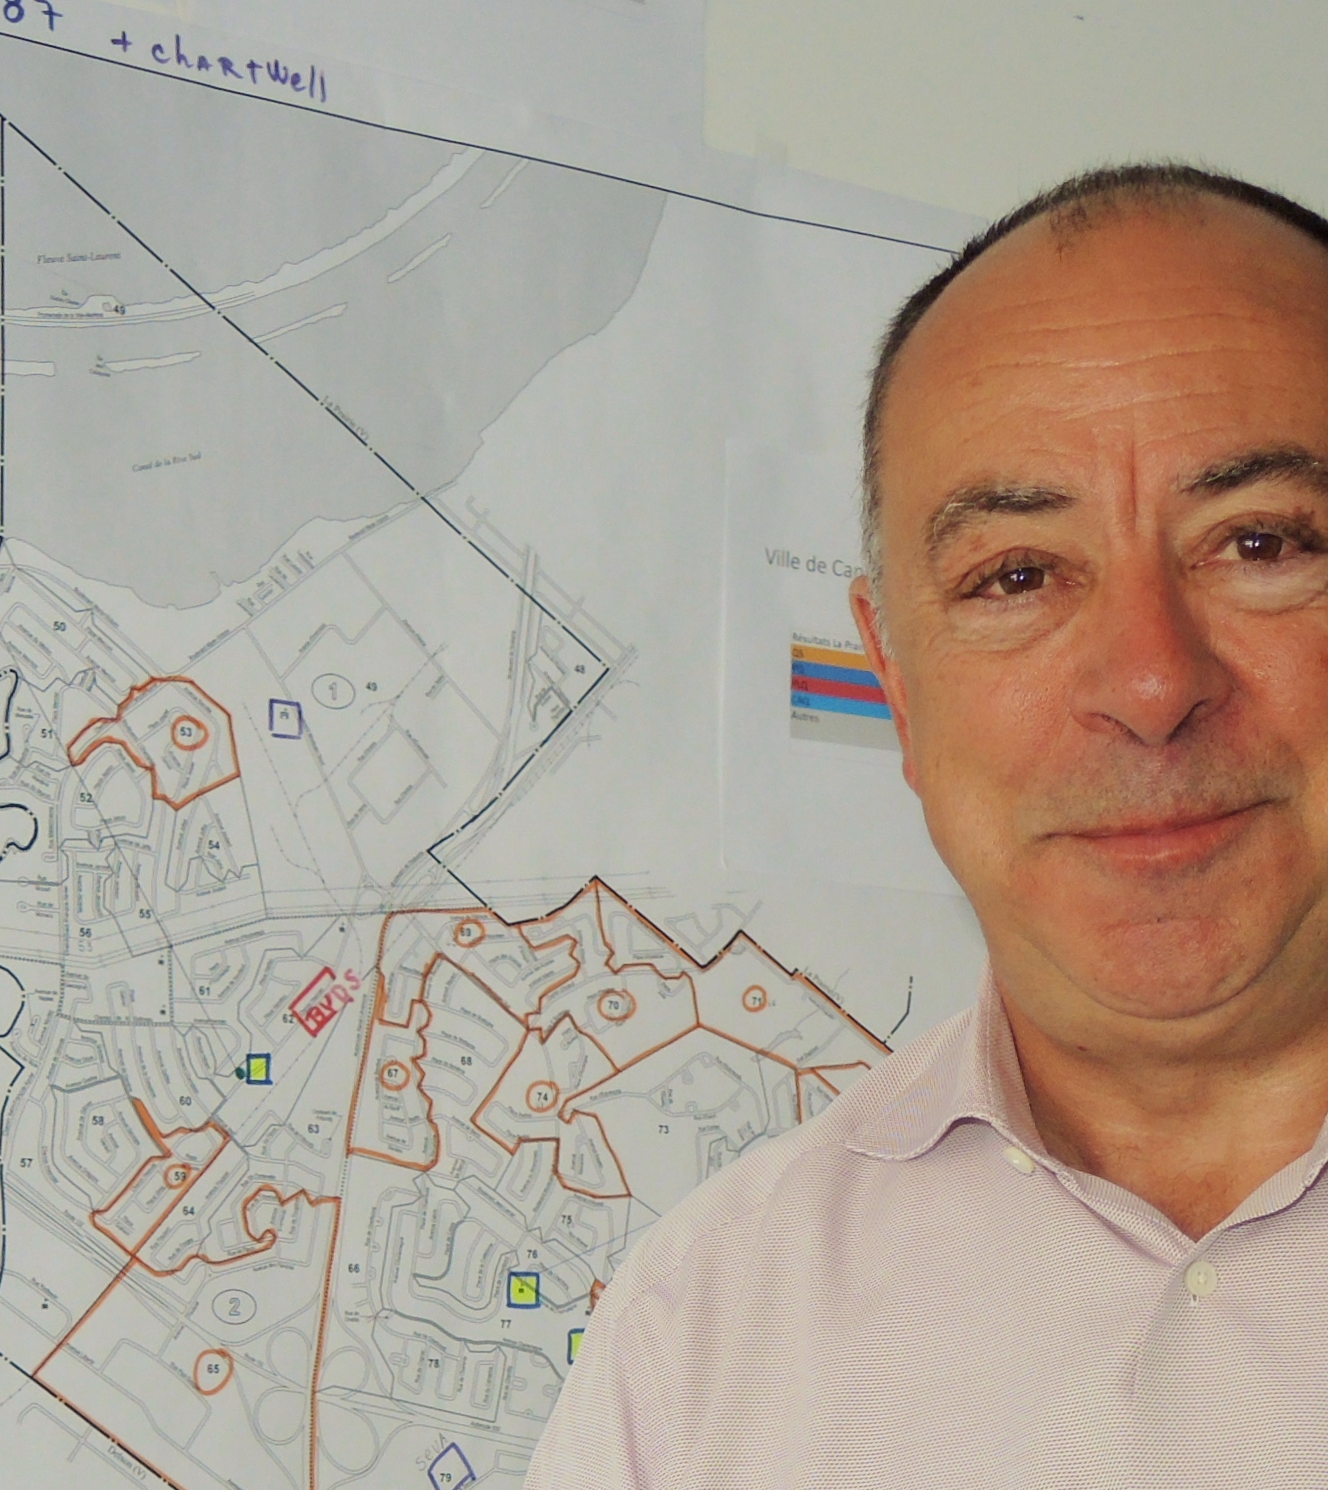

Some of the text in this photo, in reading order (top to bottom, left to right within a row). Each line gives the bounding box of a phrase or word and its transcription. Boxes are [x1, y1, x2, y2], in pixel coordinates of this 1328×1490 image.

[765, 548, 827, 574] Ville de
[53, 621, 66, 632] 50
[180, 727, 192, 738] 53
[139, 909, 151, 920] 55
[174, 1171, 187, 1182] 59
